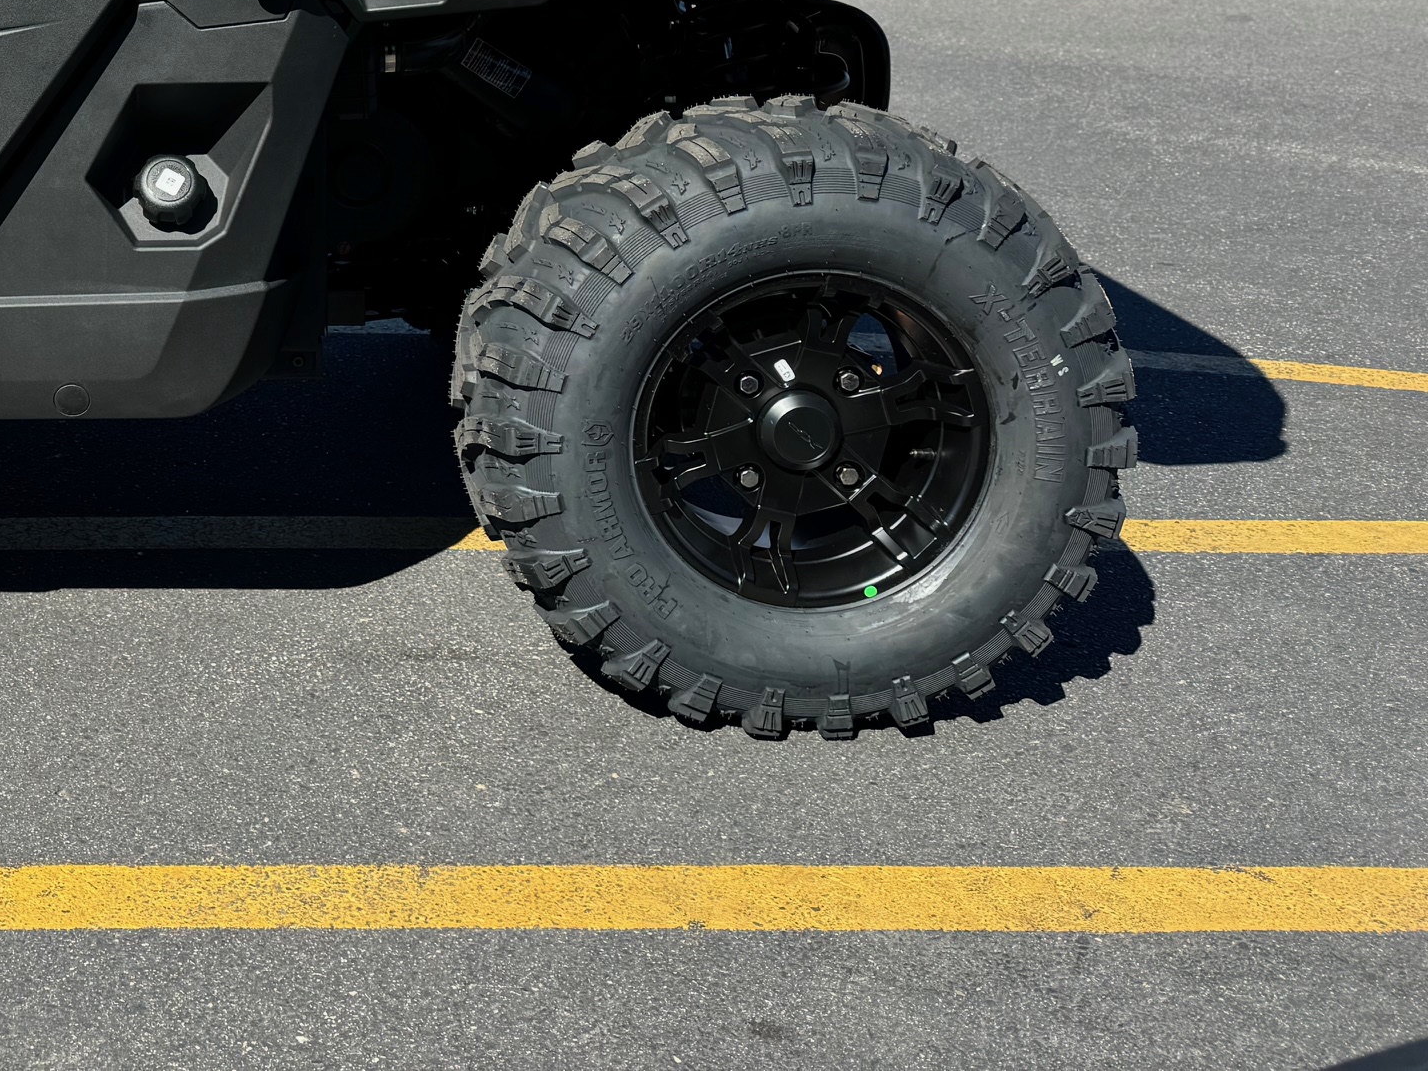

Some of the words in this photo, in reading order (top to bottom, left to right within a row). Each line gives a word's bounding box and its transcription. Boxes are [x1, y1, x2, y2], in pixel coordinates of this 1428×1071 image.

[968, 283, 1066, 484] X-TERRAIN
[584, 451, 635, 561] ARMOR
[624, 562, 678, 620] PRO
